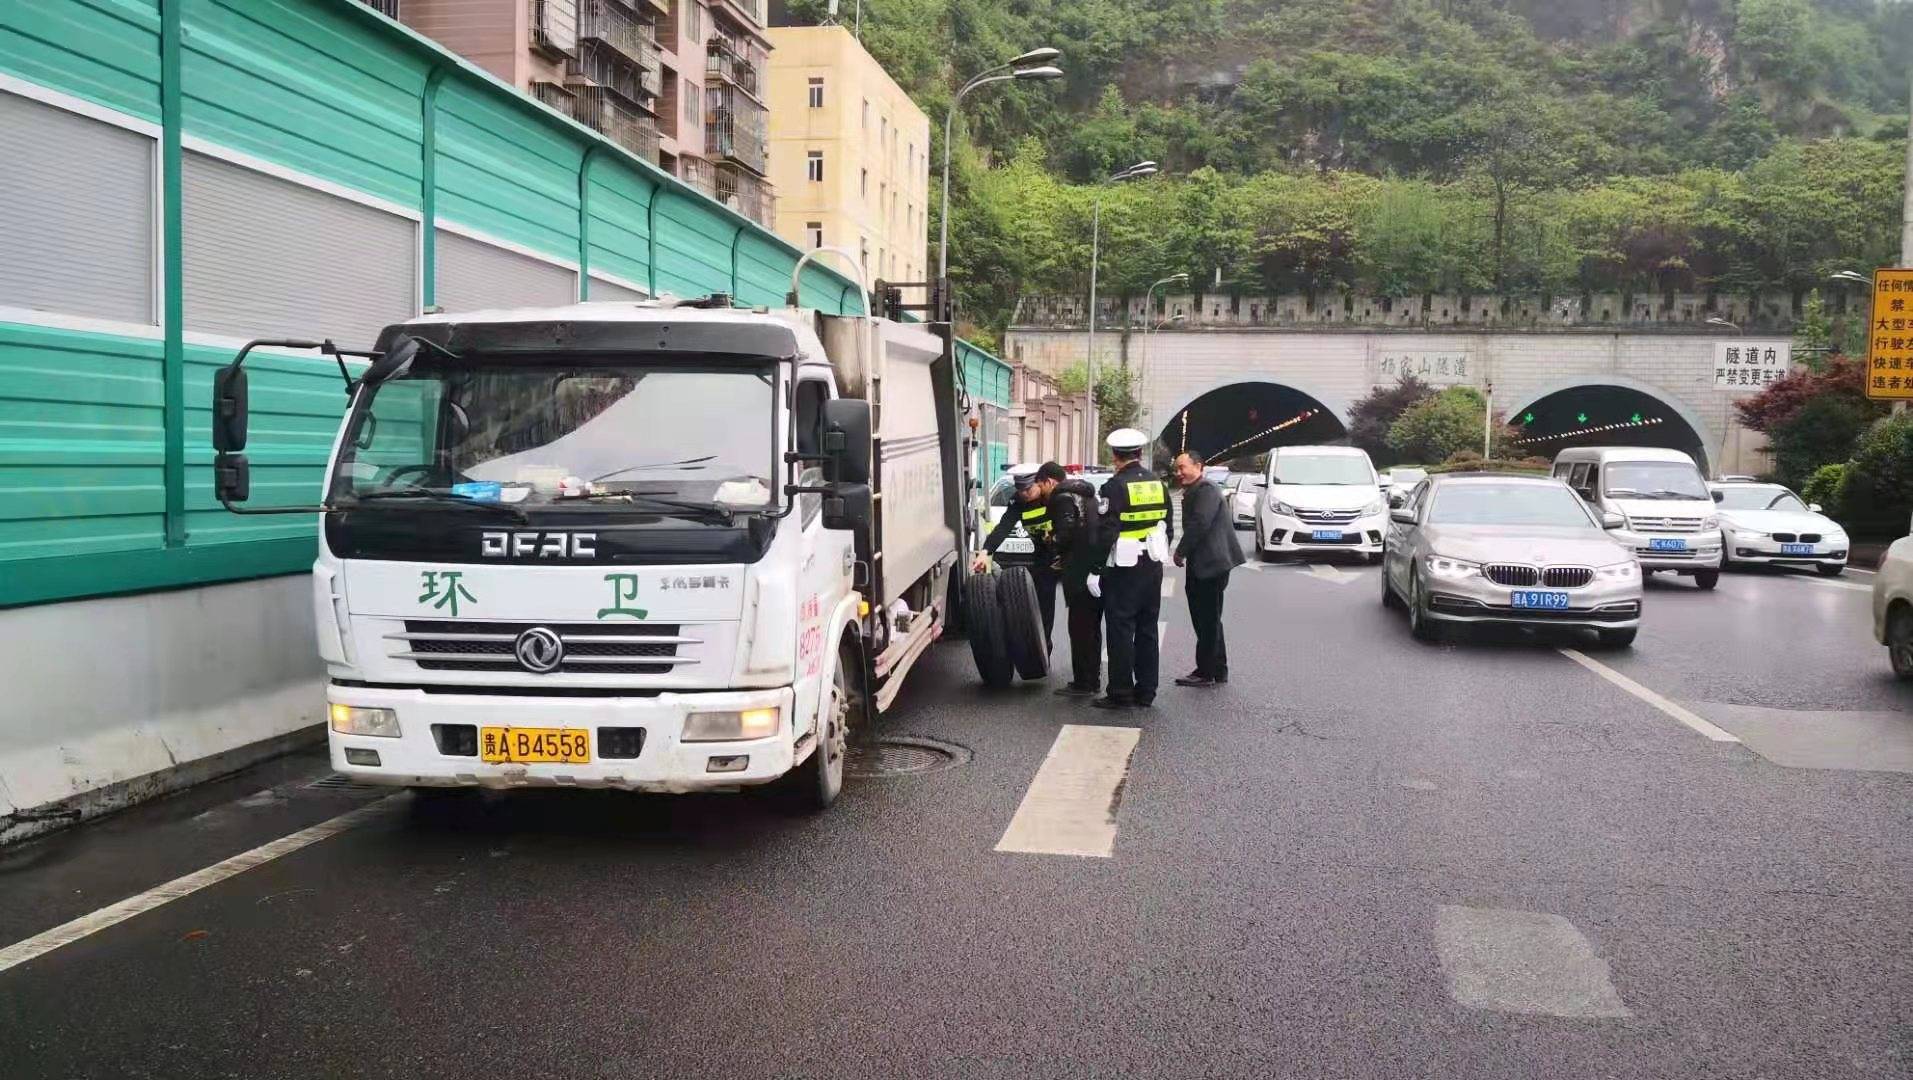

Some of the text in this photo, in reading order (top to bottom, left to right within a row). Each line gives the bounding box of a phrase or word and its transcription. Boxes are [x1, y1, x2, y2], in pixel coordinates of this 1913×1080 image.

[1727, 347, 1776, 365] 隧道内
[1715, 368, 1786, 385] 严禁变更车道
[481, 532, 597, 558] DFAC
